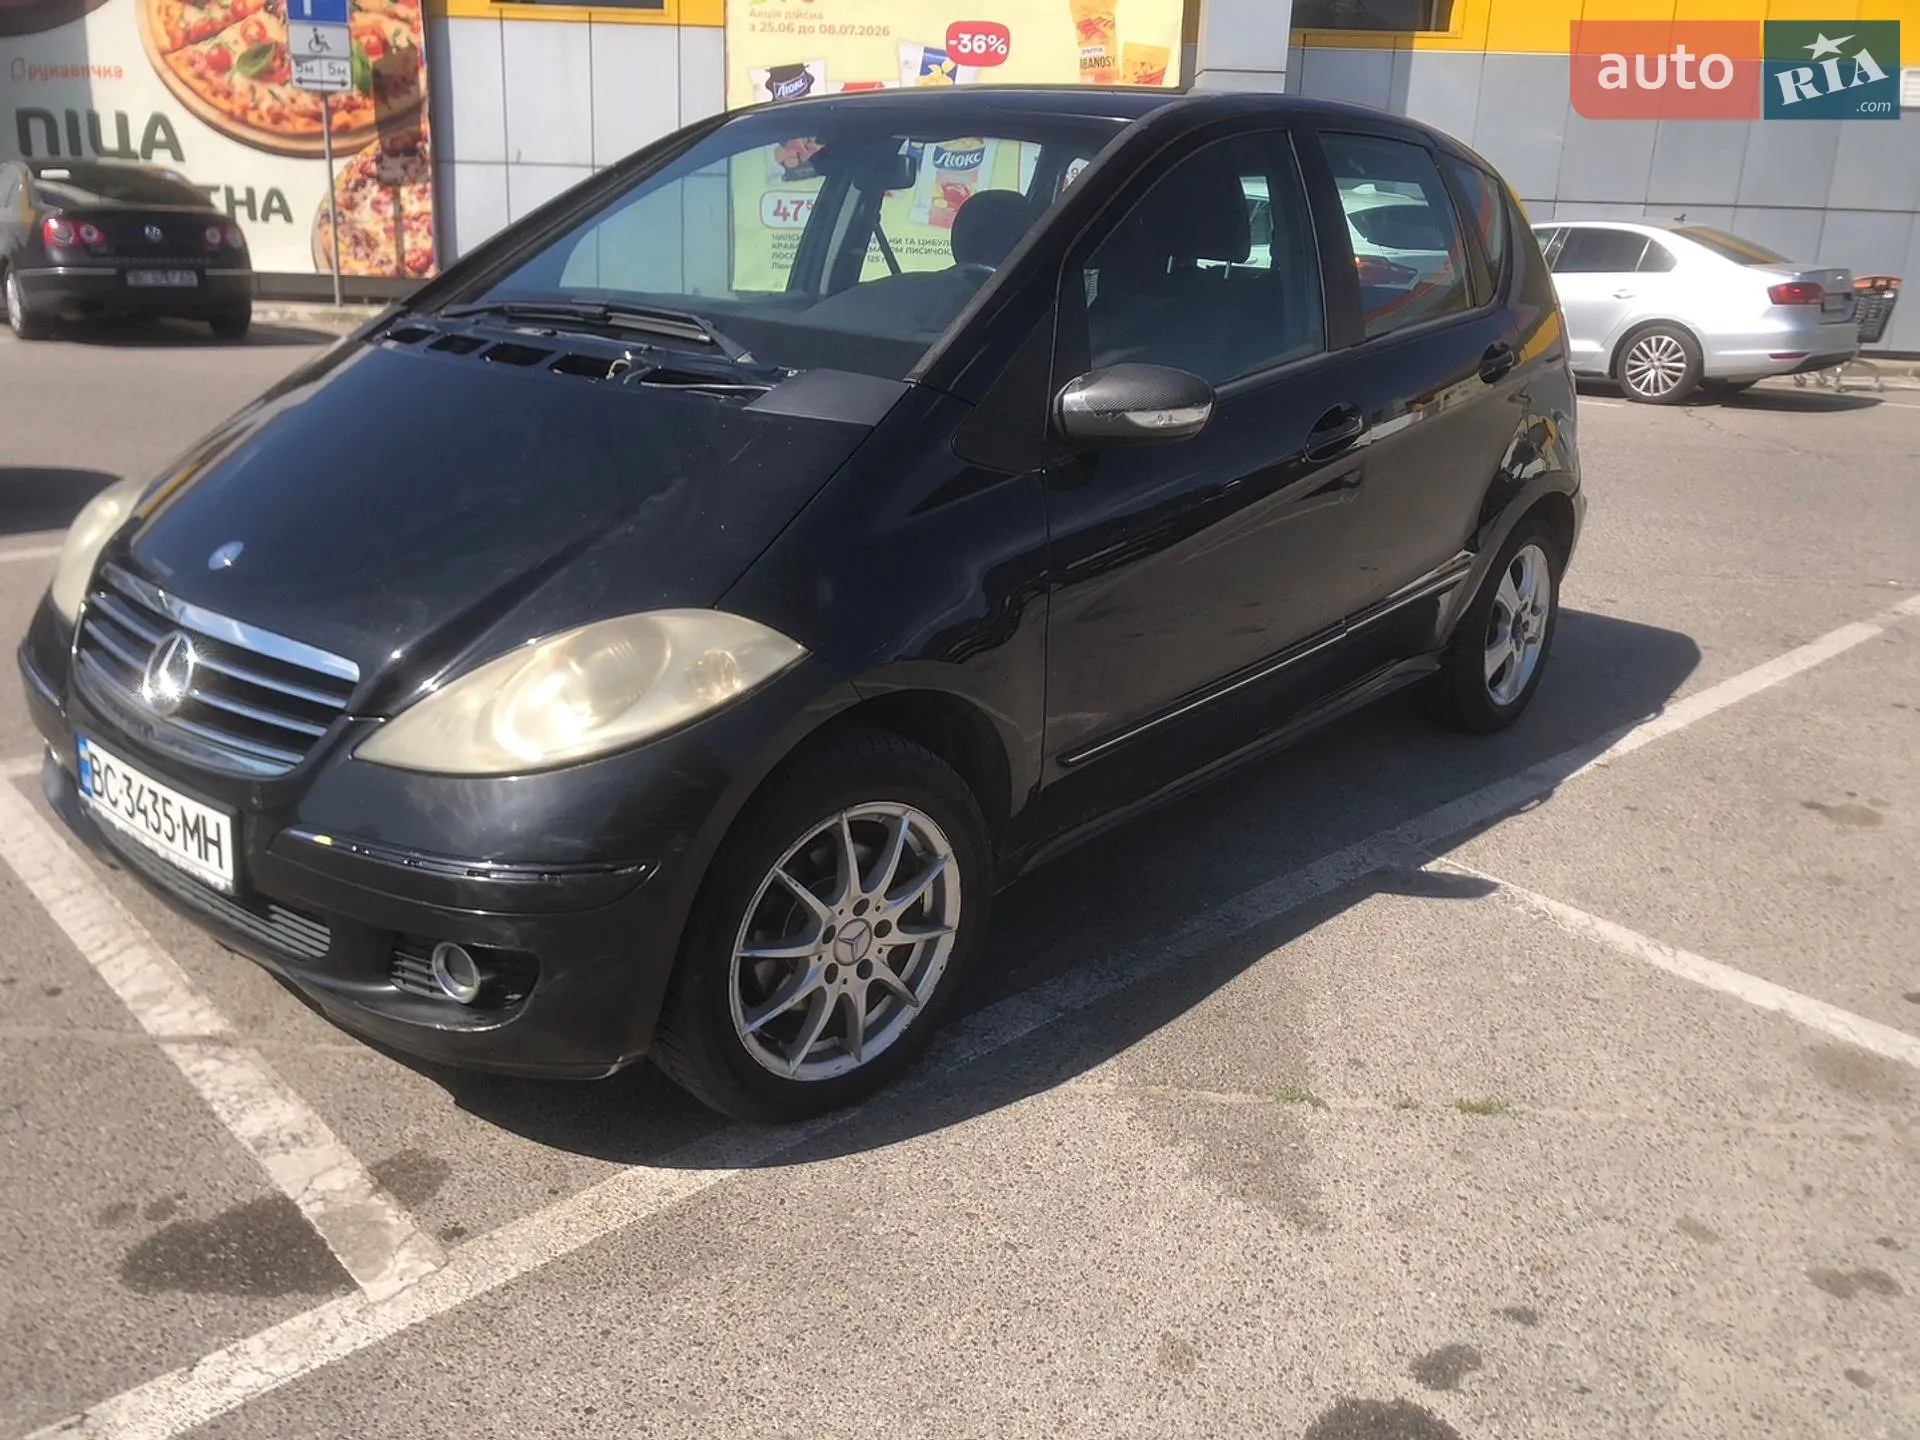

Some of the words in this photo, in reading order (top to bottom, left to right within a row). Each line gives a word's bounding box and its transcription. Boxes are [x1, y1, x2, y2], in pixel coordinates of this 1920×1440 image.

[760, 22, 795, 33] 25.06
[798, 24, 816, 35] до
[819, 24, 891, 36] 08.07.2026
[948, 33, 1008, 55] -36%
[15, 106, 186, 162] ПІЦА
[918, 239, 950, 247] ЦИБУЛ
